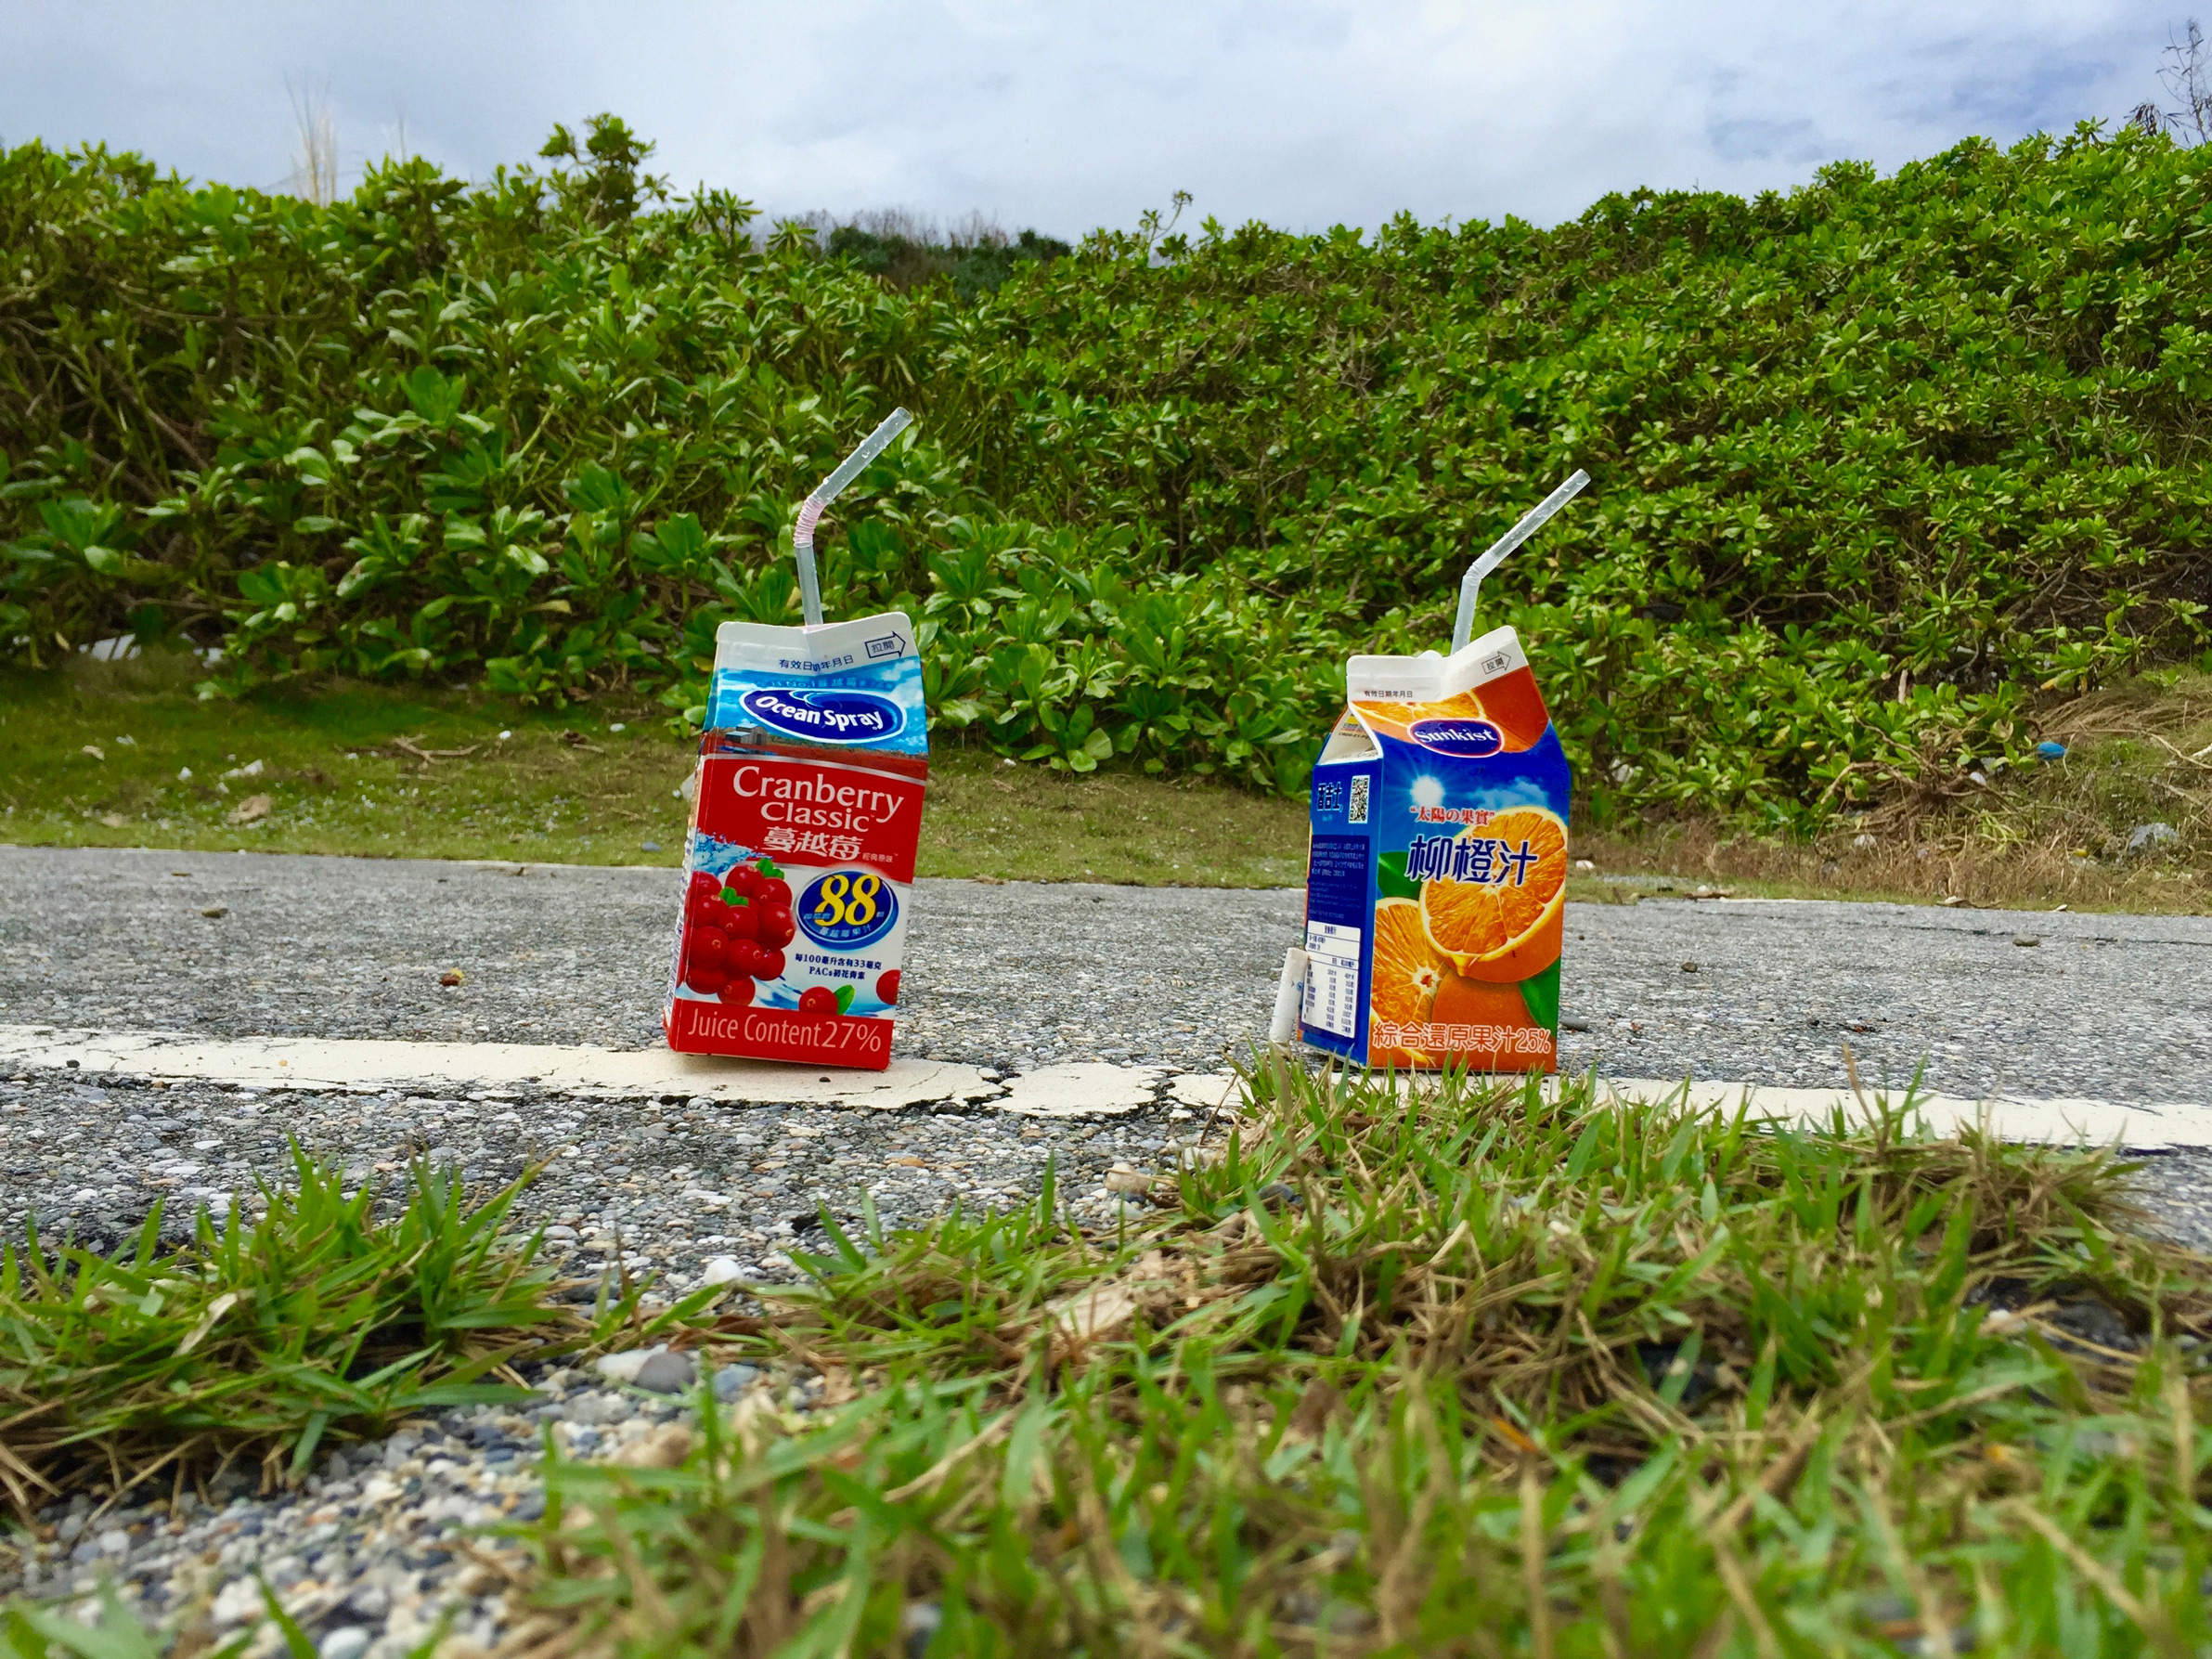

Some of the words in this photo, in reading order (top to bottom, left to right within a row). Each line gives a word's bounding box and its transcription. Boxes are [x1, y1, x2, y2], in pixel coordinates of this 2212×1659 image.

[871, 640, 895, 654] 拉開
[1364, 690, 1413, 698] 有效日期年月日
[756, 695, 821, 725] Ocean
[824, 709, 883, 732] Spray
[1415, 728, 1498, 744] Sunkist
[732, 766, 905, 823] Cranberry
[760, 801, 870, 833] Classic
[761, 826, 864, 861] 蔓越莓
[1404, 834, 1539, 887] 柳橙汁
[814, 875, 881, 927] 88
[795, 953, 882, 970] 每100毫升含有33毫克
[688, 1008, 739, 1040] Juice
